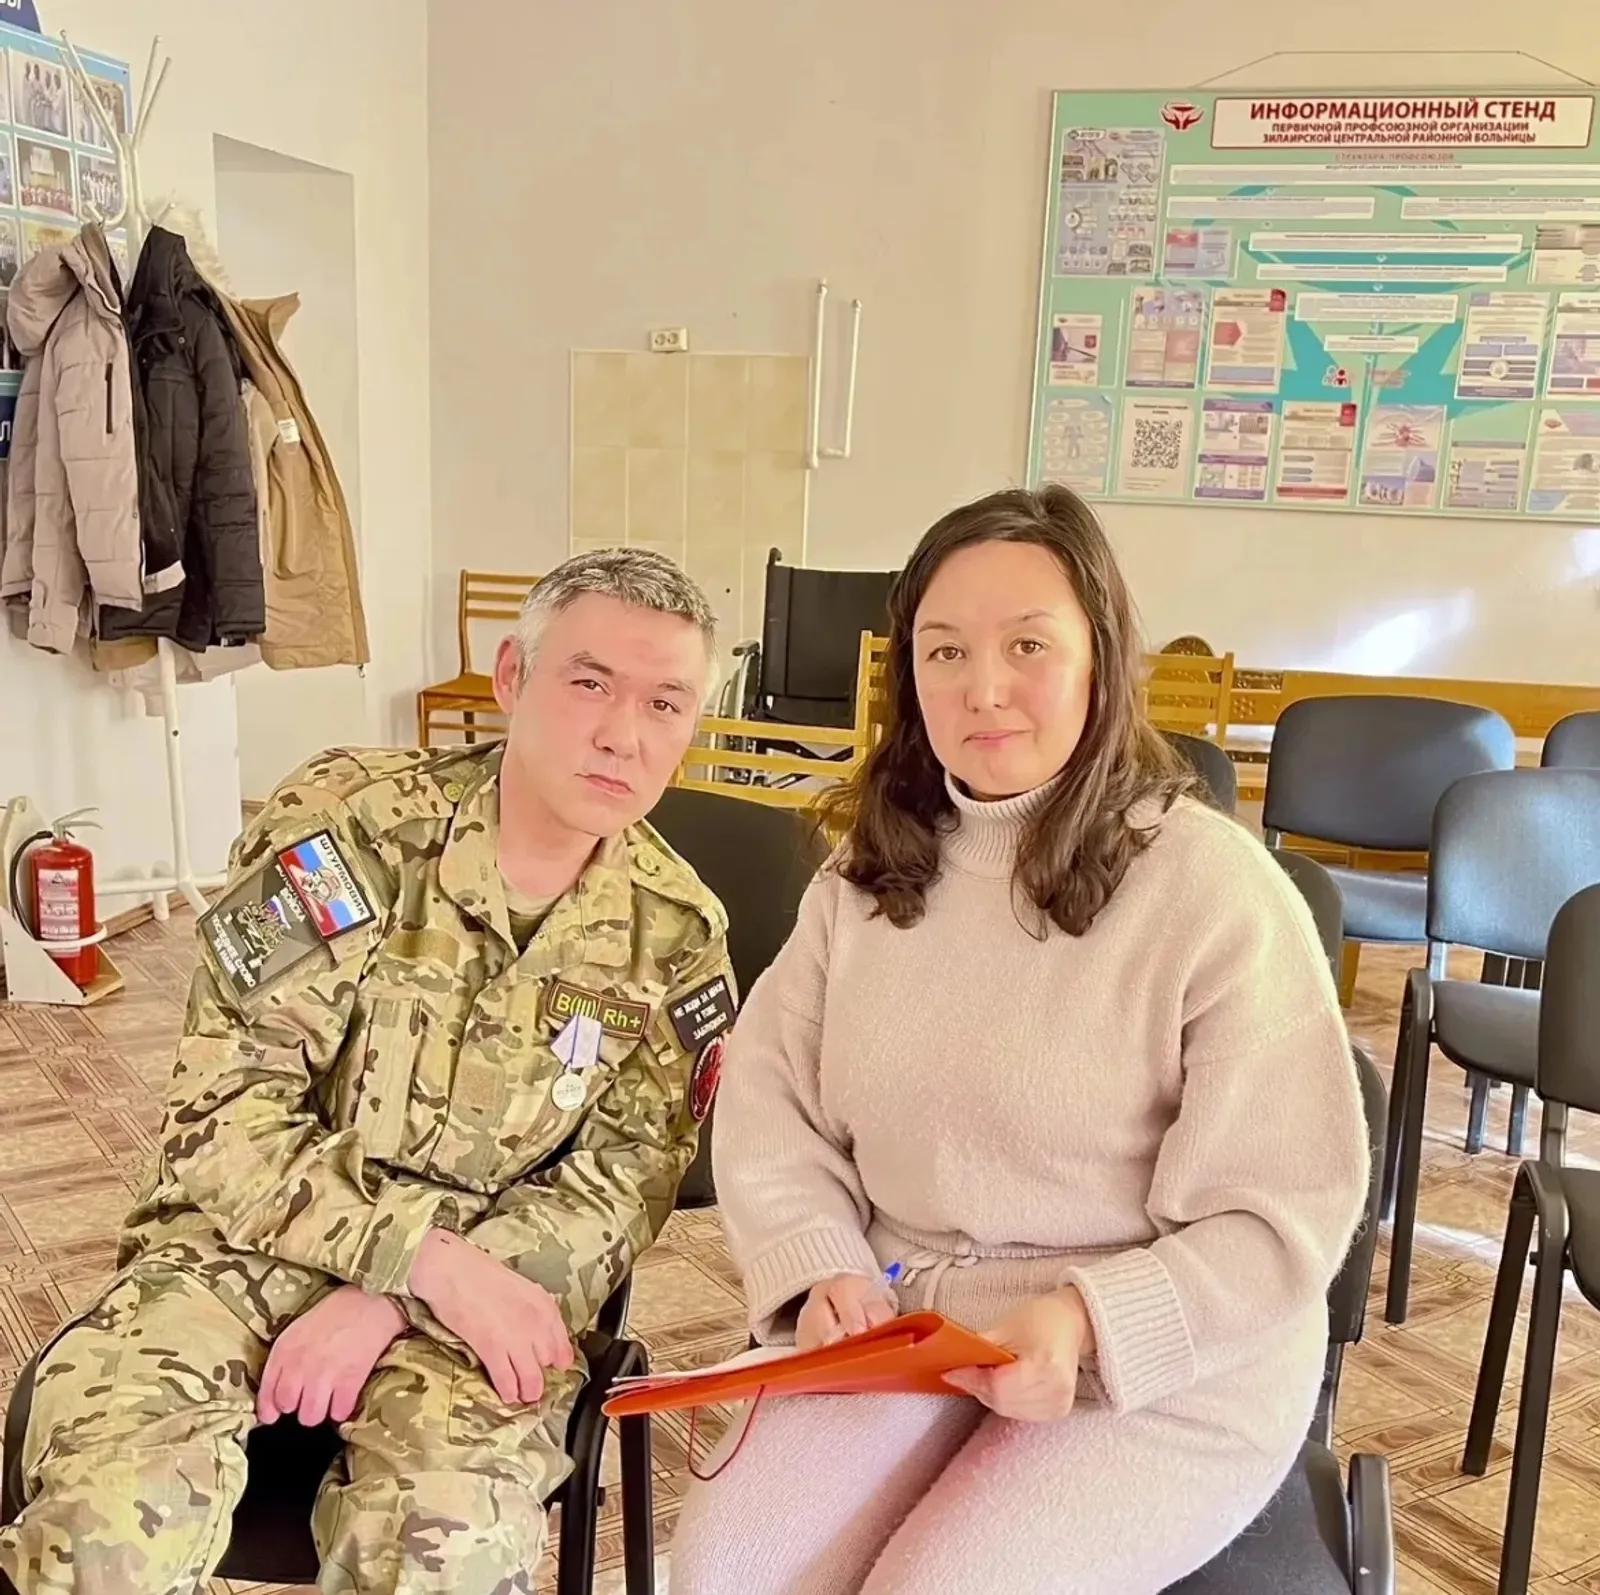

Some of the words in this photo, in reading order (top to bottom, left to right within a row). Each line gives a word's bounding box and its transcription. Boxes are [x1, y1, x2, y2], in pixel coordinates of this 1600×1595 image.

[1250, 97, 1478, 121] ИНФОРМАЦИОННЫЙ
[1484, 101, 1555, 121] СТЕНД
[1263, 132, 1331, 144] ЗИЛАИРСКОЙ
[1334, 132, 1410, 144] ЦЕНТРАЛЬНОЙ
[1412, 132, 1472, 143] РАЙОННОЙ
[1474, 132, 1535, 144] БОЛЬНИЦЫ
[1272, 122, 1341, 133] ПЕРВИЧНОЙ
[1345, 121, 1437, 133] ПРОФСОЮЗНОЙ
[1440, 121, 1529, 133] ОРГАНИЗАЦИИ
[319, 837, 368, 917] ШТУРМОВИК
[279, 886, 306, 923] ВОЙСКА
[233, 957, 257, 988] СЛОВО
[603, 1008, 642, 1029] Rh+
